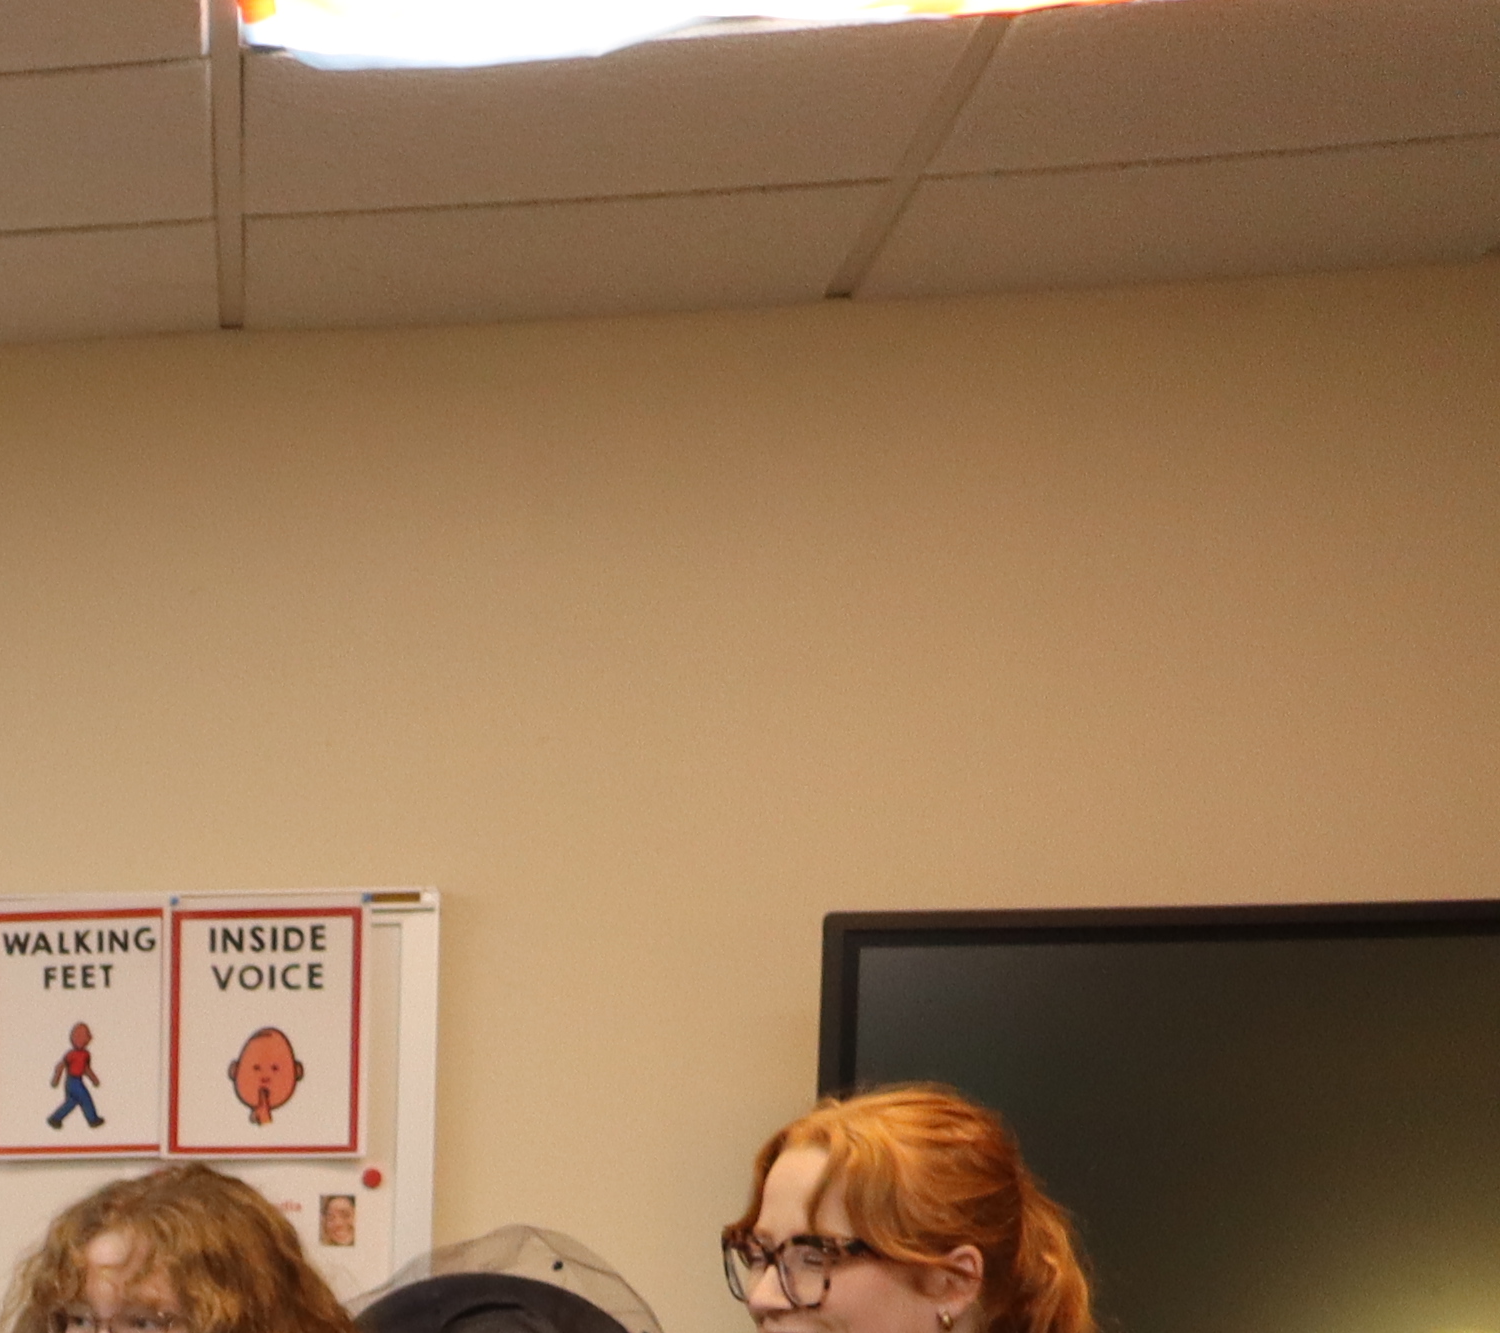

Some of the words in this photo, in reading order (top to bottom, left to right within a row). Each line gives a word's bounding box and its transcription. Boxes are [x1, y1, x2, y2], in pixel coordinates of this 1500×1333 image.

[4, 926, 156, 956] WALKING
[209, 925, 327, 953] INSIDE
[43, 965, 114, 989] FEET
[211, 963, 325, 991] VOICE
